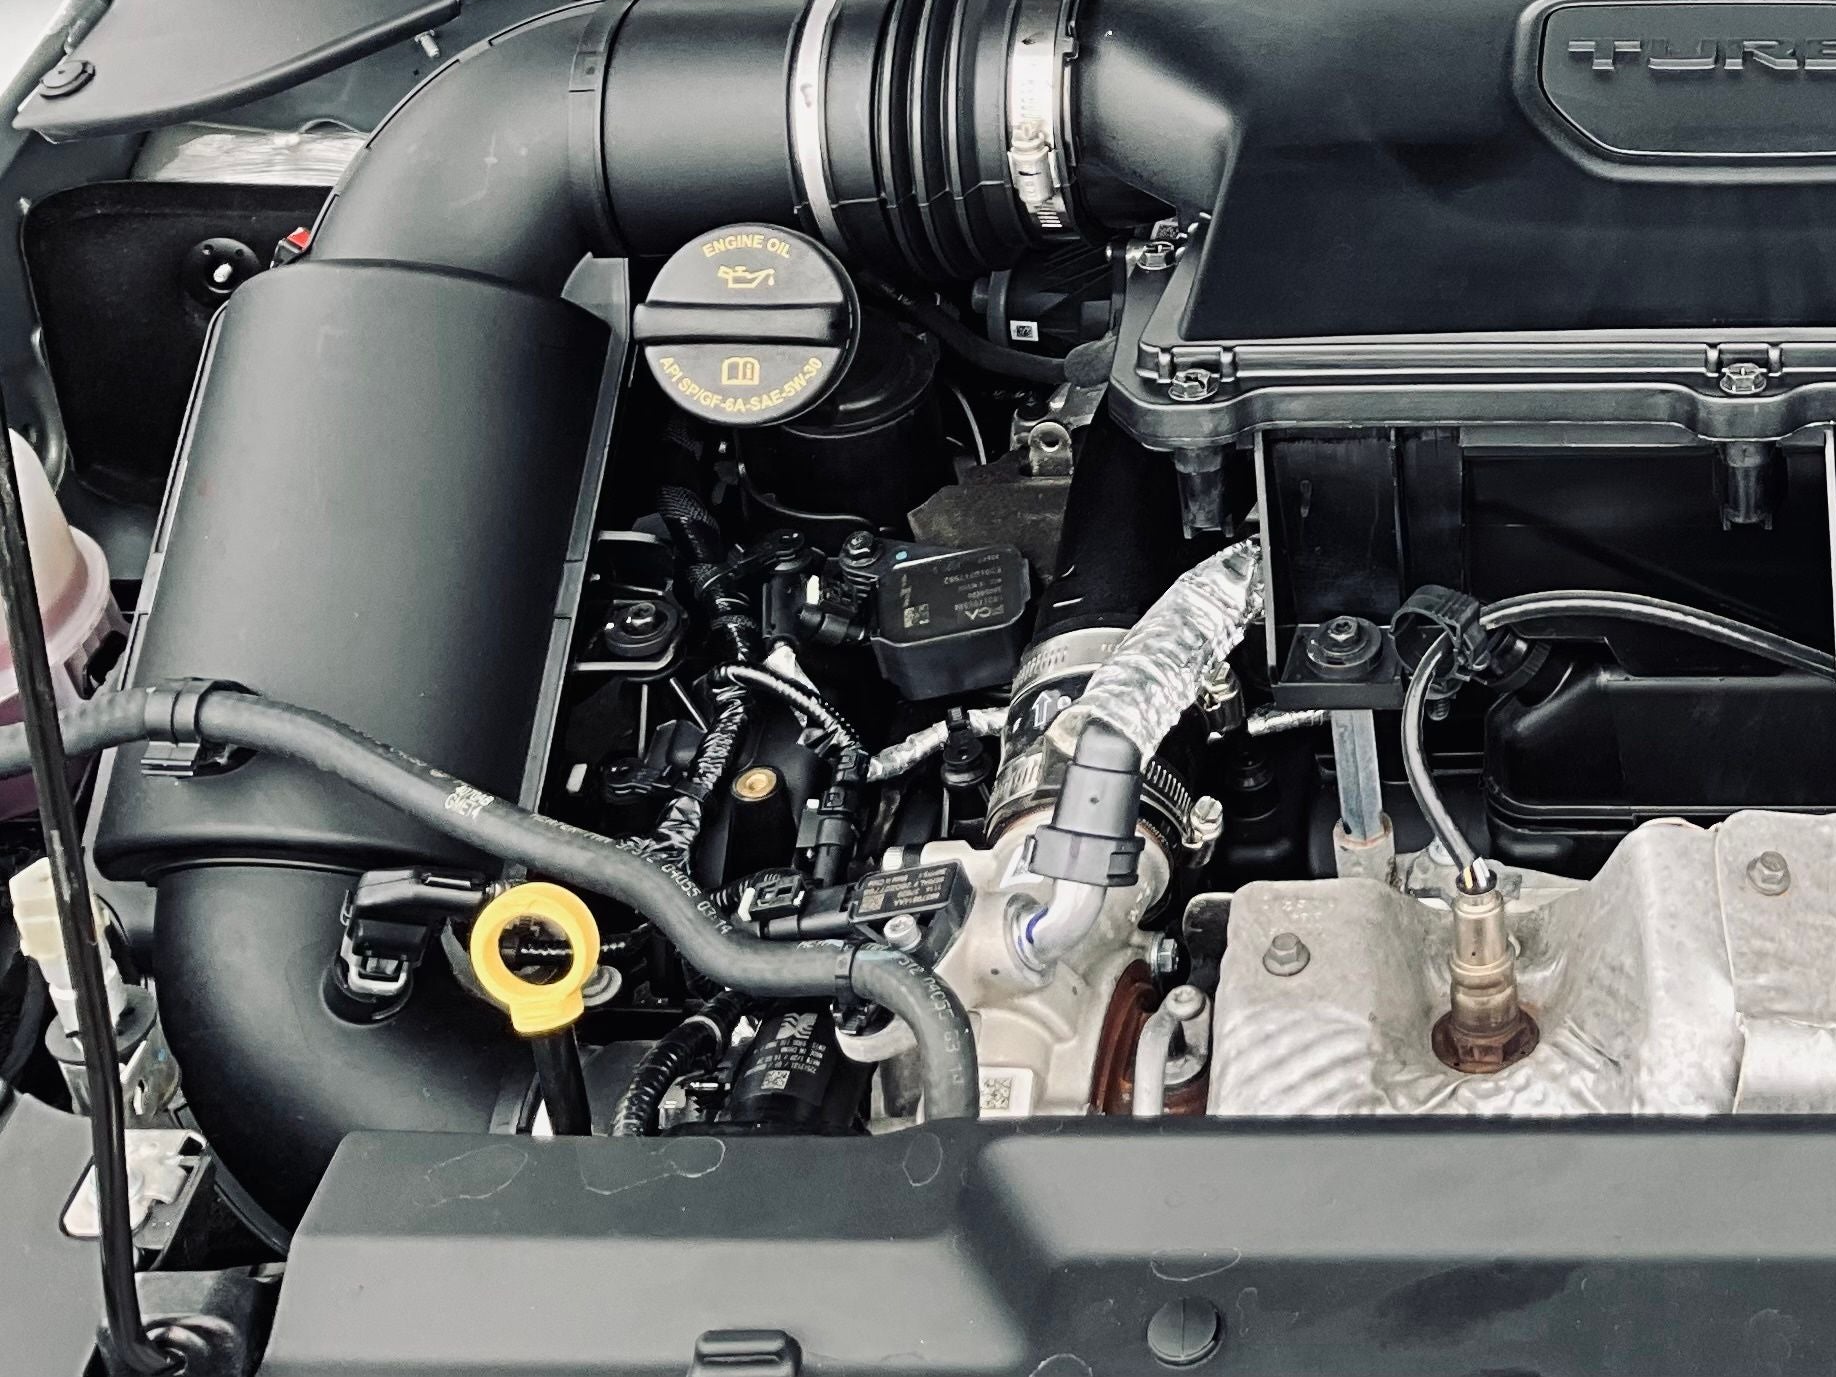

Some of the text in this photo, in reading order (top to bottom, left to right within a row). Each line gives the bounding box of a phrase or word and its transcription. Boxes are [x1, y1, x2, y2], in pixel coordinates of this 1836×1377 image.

[702, 234, 792, 259] ENGINE OIL
[659, 356, 681, 382] API
